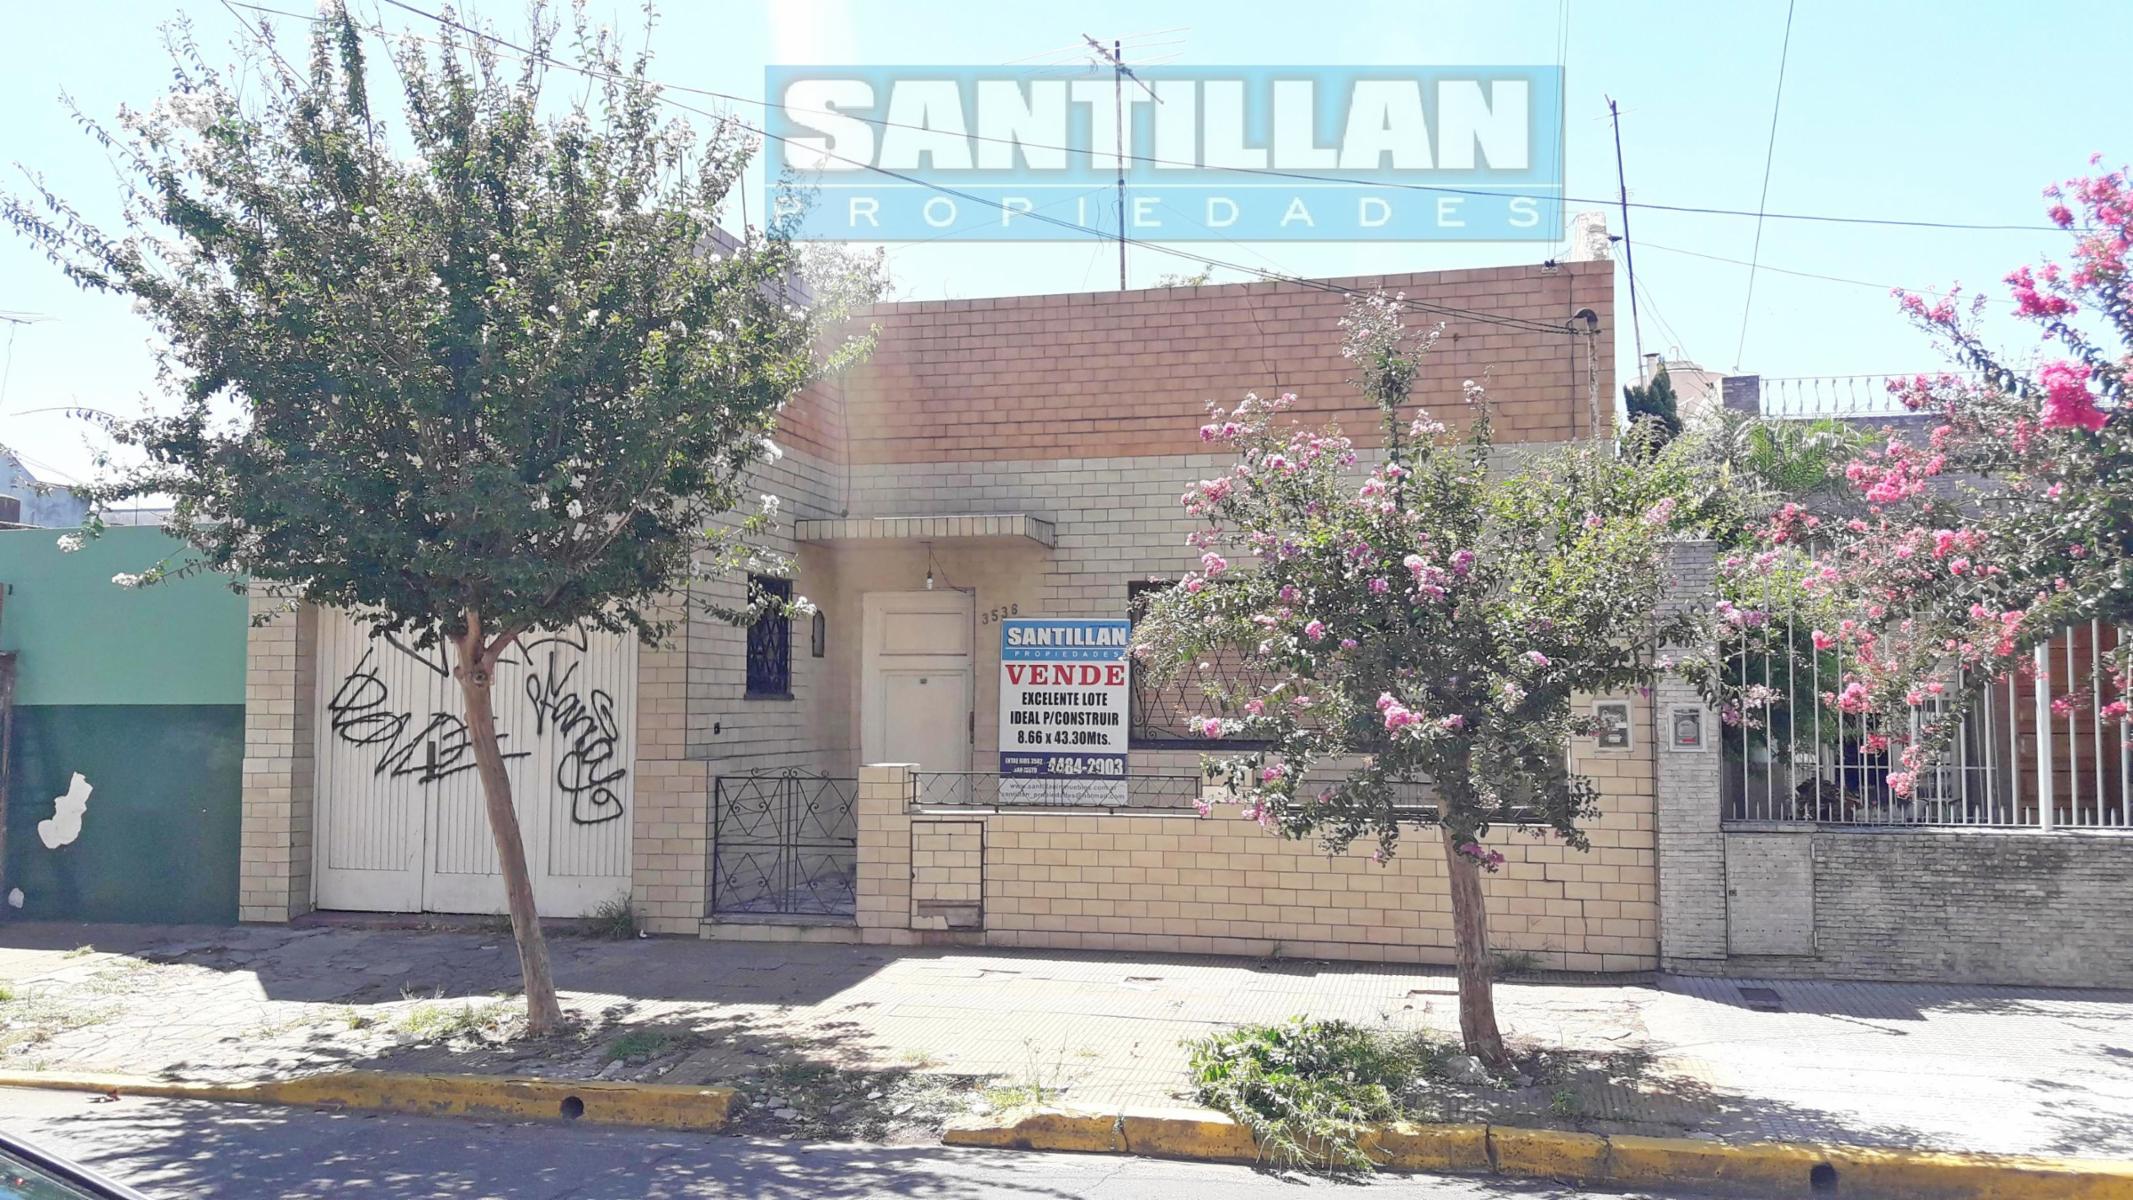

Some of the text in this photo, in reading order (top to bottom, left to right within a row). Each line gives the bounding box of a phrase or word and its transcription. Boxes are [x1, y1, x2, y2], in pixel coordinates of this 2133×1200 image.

[982, 603, 1018, 625] 3536
[1008, 627, 1127, 646] SANTILLAN
[1014, 650, 1119, 658] PROPIEDADES
[1005, 664, 1125, 686] VENDE
[1022, 691, 1108, 706] EXCELENTE LOTE
[1010, 711, 1119, 726] IDEAL P/CONSTRUIR
[1017, 730, 1111, 746] 8.66 x 43.30Mts.
[1047, 757, 1124, 775] 4484-2903
